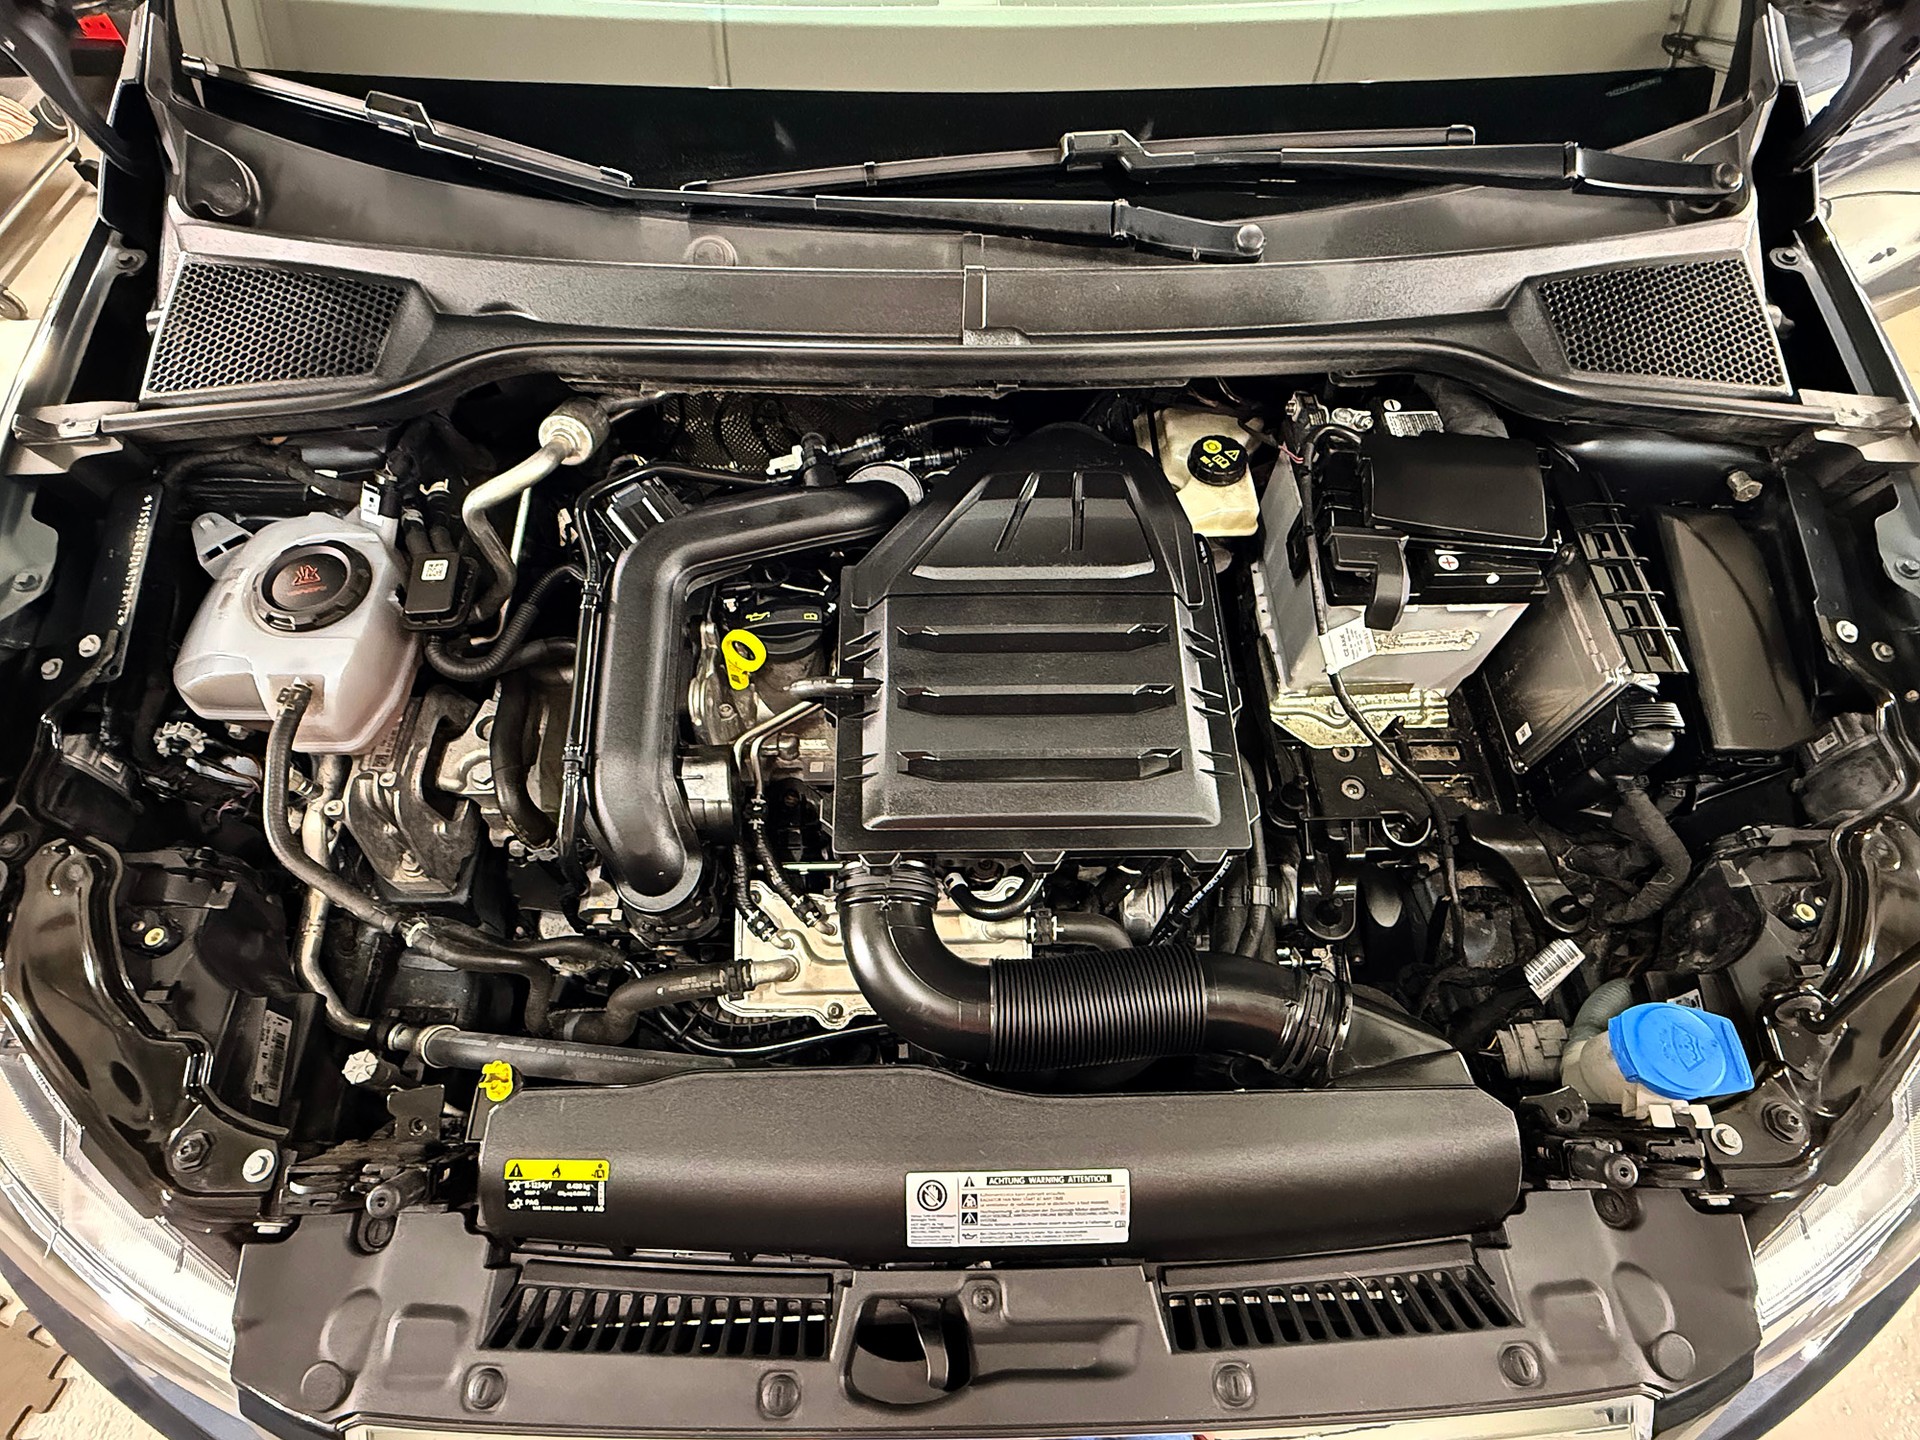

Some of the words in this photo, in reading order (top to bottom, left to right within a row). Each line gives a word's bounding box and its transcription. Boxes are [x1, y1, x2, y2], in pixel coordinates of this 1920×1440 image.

[988, 1177, 1025, 1185] ACHTUNG
[1028, 1176, 1065, 1184] WARNING
[1068, 1174, 1108, 1183] ATTENTION
[524, 1198, 539, 1206] PAG
